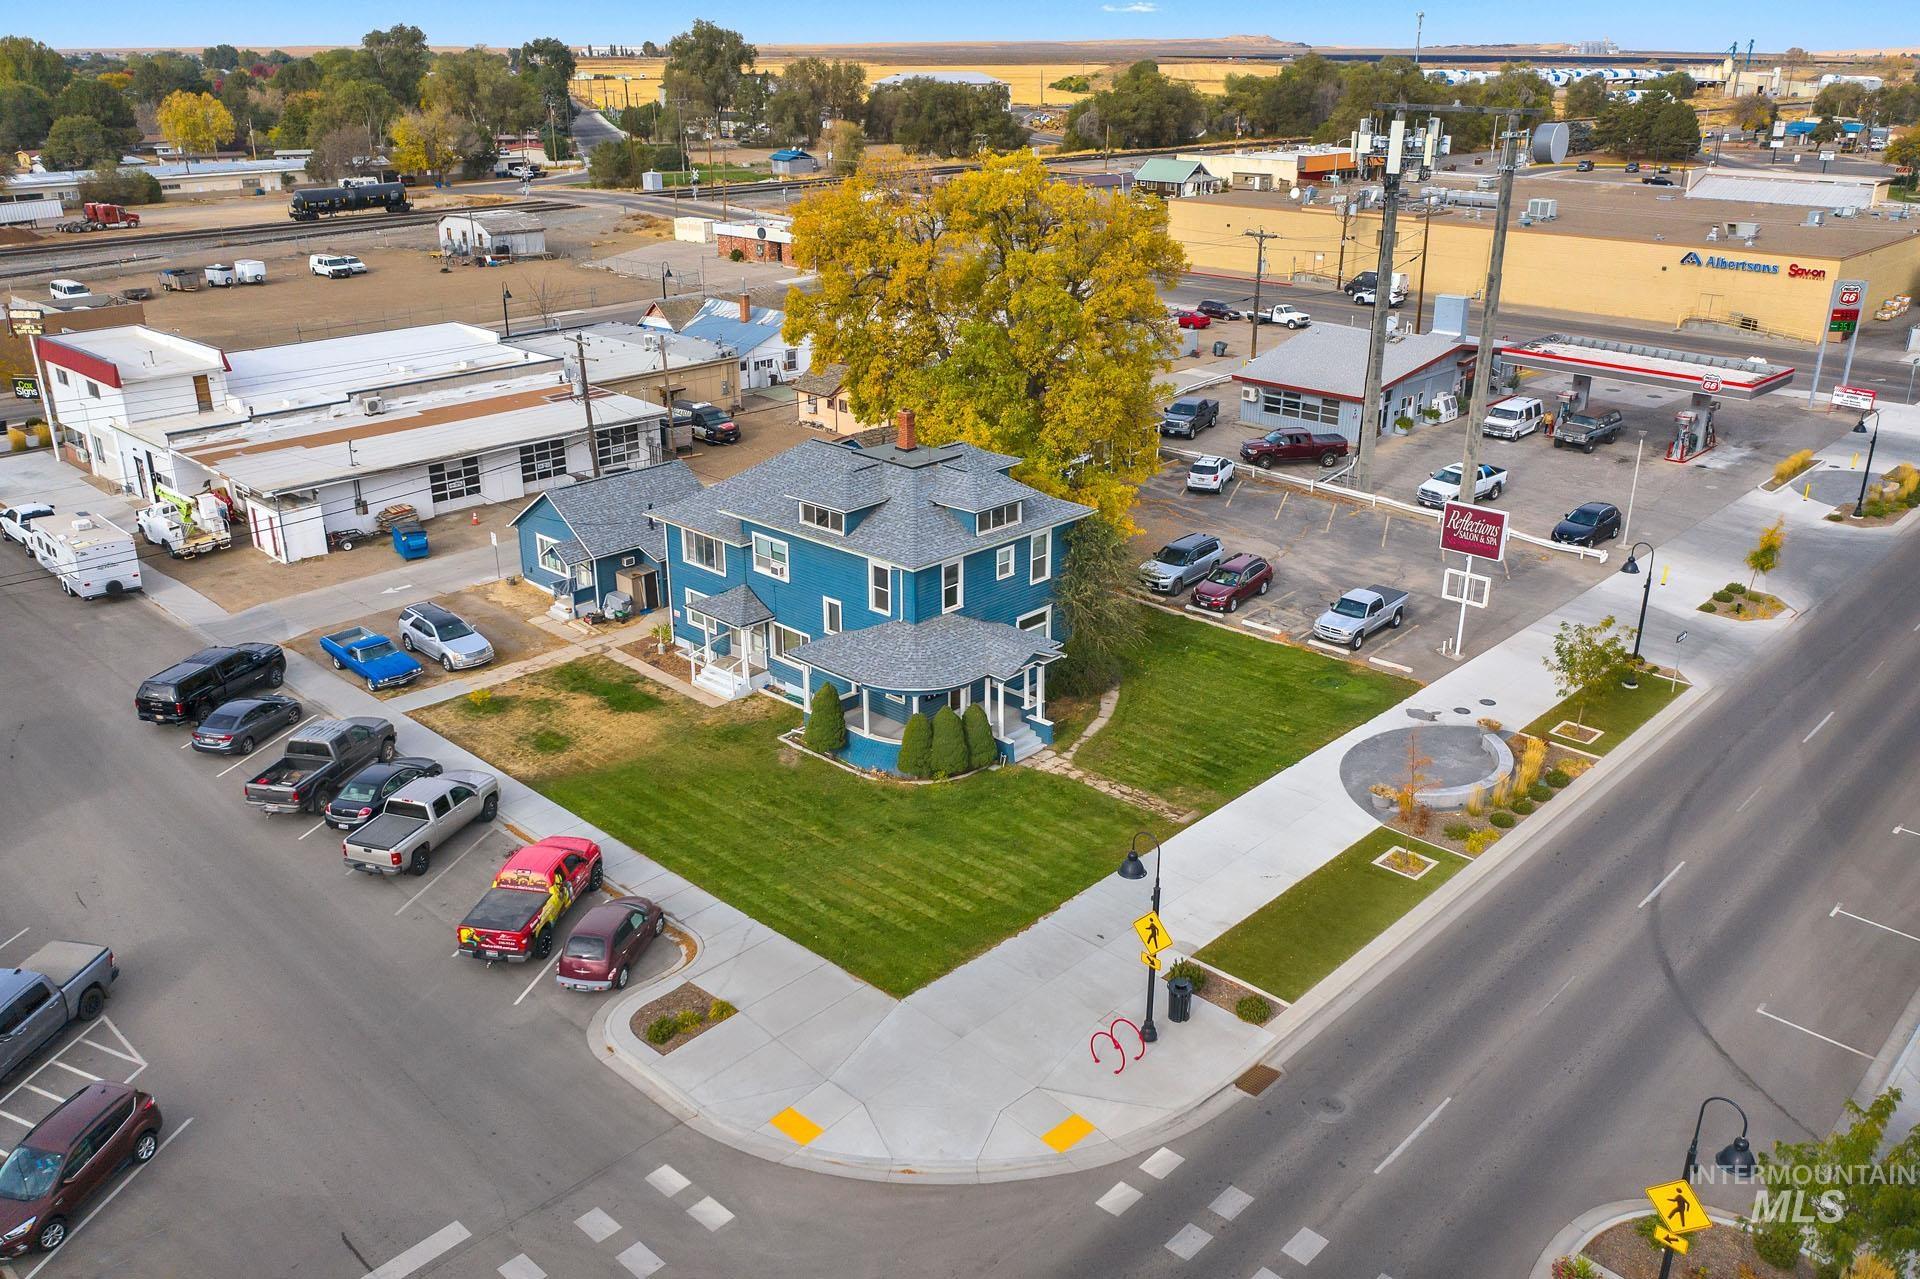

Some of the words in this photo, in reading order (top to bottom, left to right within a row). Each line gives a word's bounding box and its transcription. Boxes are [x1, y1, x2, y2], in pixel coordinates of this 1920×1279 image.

[1706, 256, 1779, 273] Albertsons
[1842, 293, 1857, 302] 66
[18, 380, 33, 389] Cox
[1703, 381, 1717, 390] 66
[16, 387, 38, 397] Signs
[1446, 510, 1500, 537] Reflections
[1458, 530, 1480, 542] SALON
[1479, 534, 1486, 544] &
[1486, 535, 1498, 546] SPA
